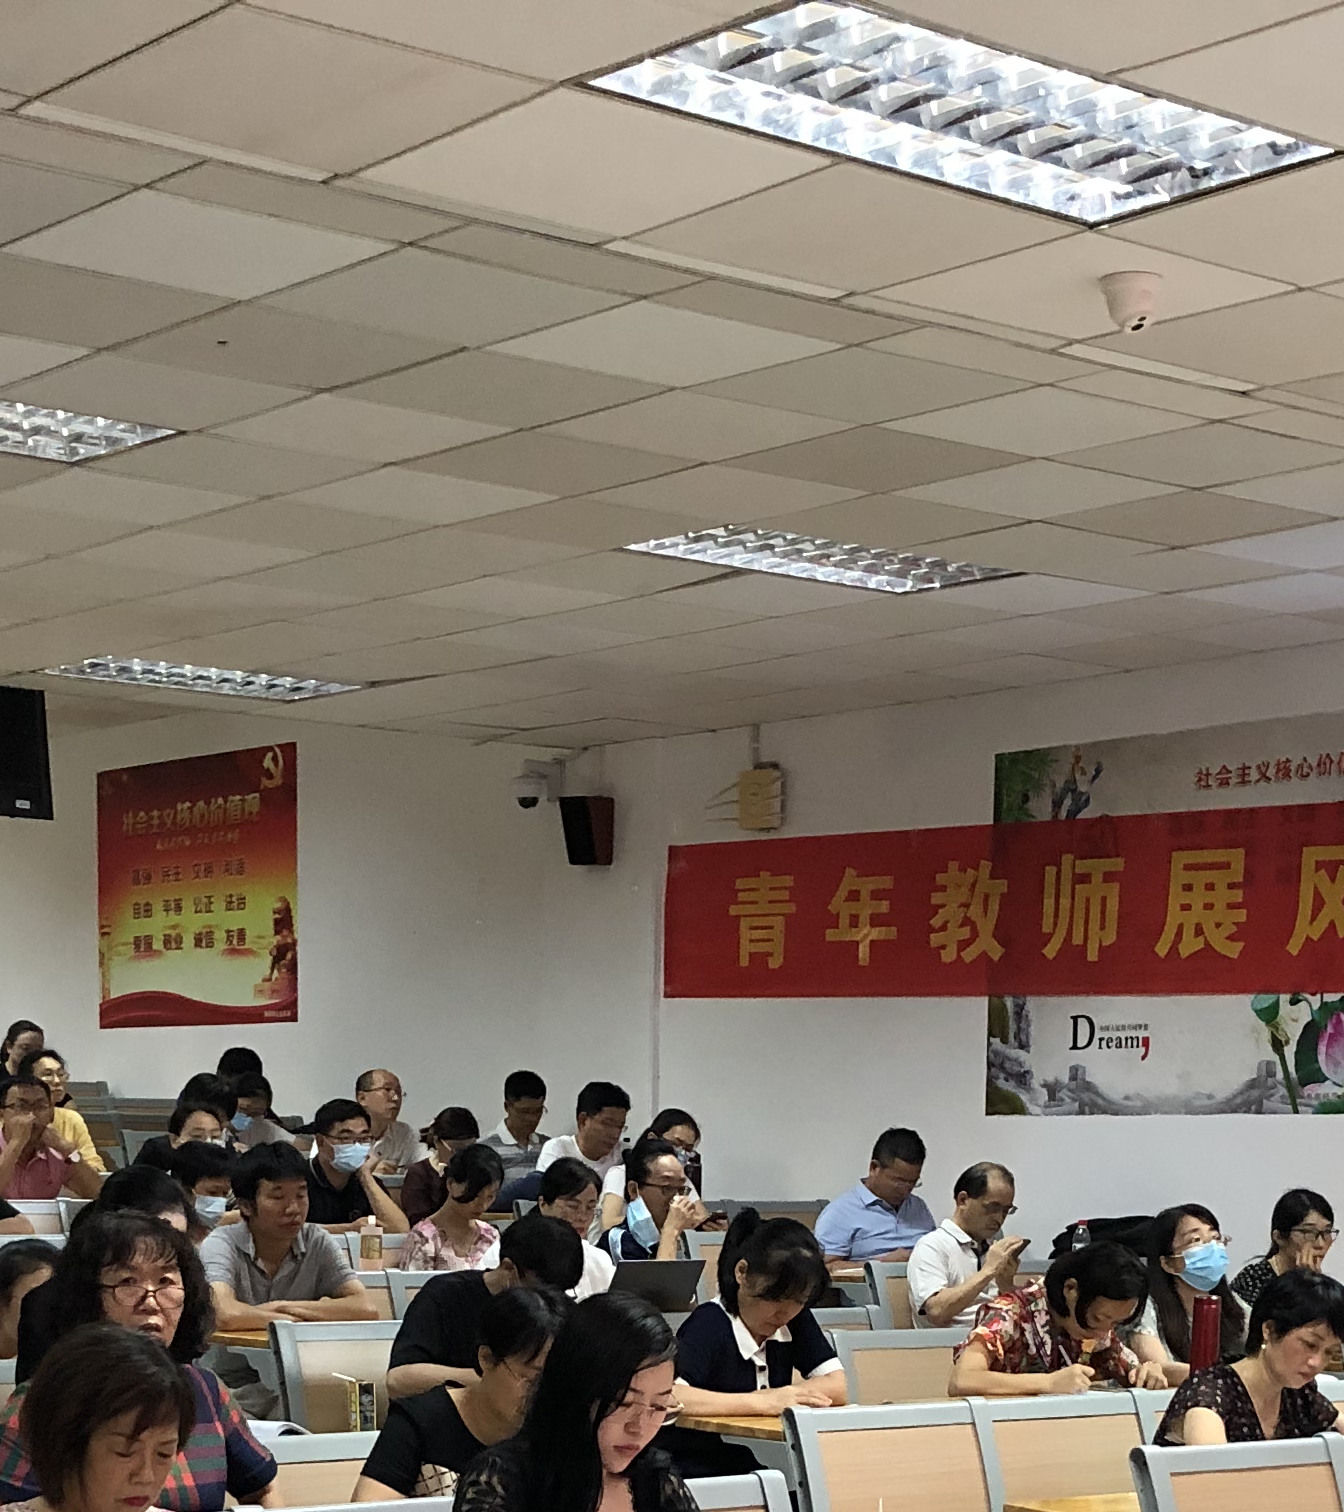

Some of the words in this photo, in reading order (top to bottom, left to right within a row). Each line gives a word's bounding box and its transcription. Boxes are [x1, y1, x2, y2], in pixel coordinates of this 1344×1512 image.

[133, 901, 153, 919] 自由
[162, 897, 184, 917] 平等
[194, 895, 214, 914] 公正
[224, 893, 247, 912] 法治
[224, 928, 247, 947] 友善
